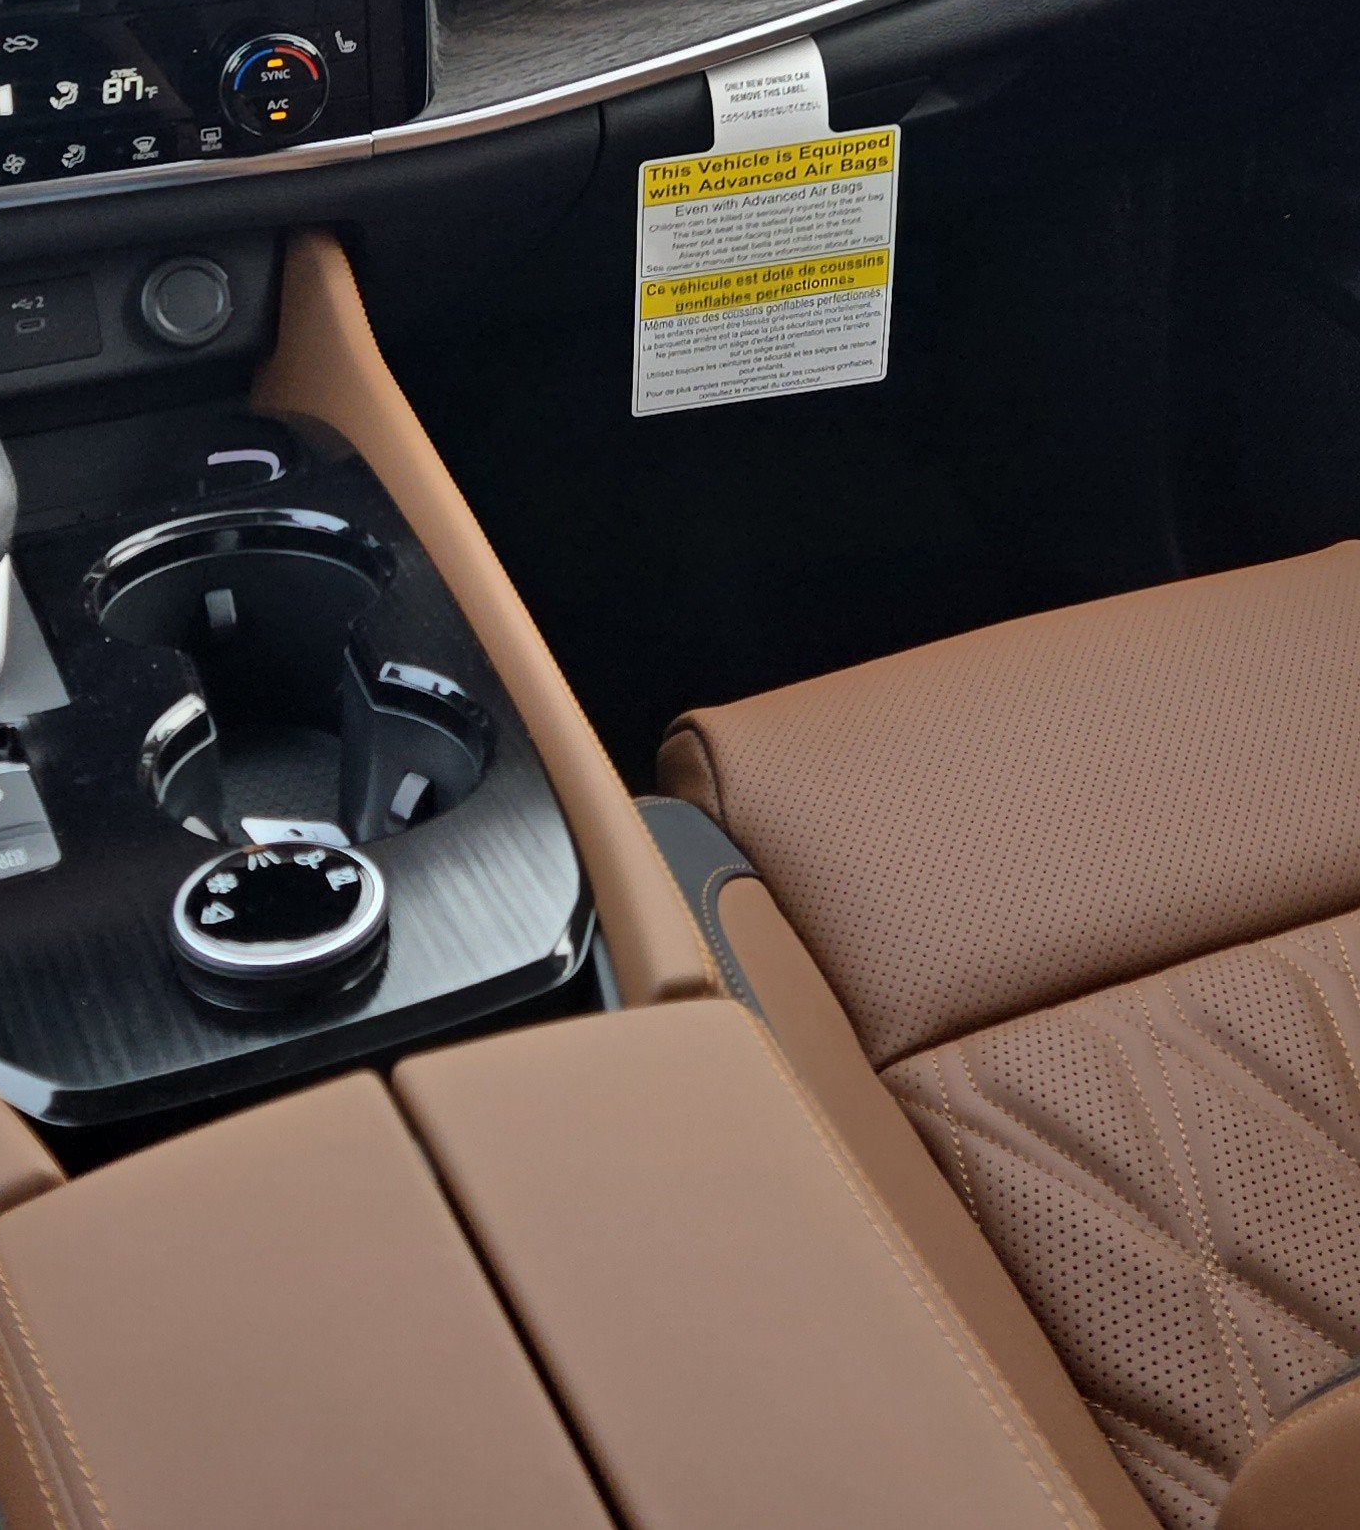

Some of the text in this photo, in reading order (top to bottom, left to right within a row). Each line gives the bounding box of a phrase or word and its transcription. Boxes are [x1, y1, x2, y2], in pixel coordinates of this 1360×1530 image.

[260, 68, 291, 82] SYNC
[267, 98, 290, 111] A/C
[649, 134, 890, 182] This Vehicle is Equipped
[648, 155, 889, 200] with Advanced Air Bags
[675, 182, 863, 217] Even with Advanced Air Bags
[646, 254, 884, 297] Ce véhicule est doté de coussins
[35, 296, 45, 309] 2
[675, 274, 855, 313] gonflables perfectionnés
[644, 318, 674, 332] Même
[676, 315, 700, 328] avec
[701, 312, 720, 324] des
[722, 305, 764, 320] coussins
[766, 298, 815, 316] gonflables
